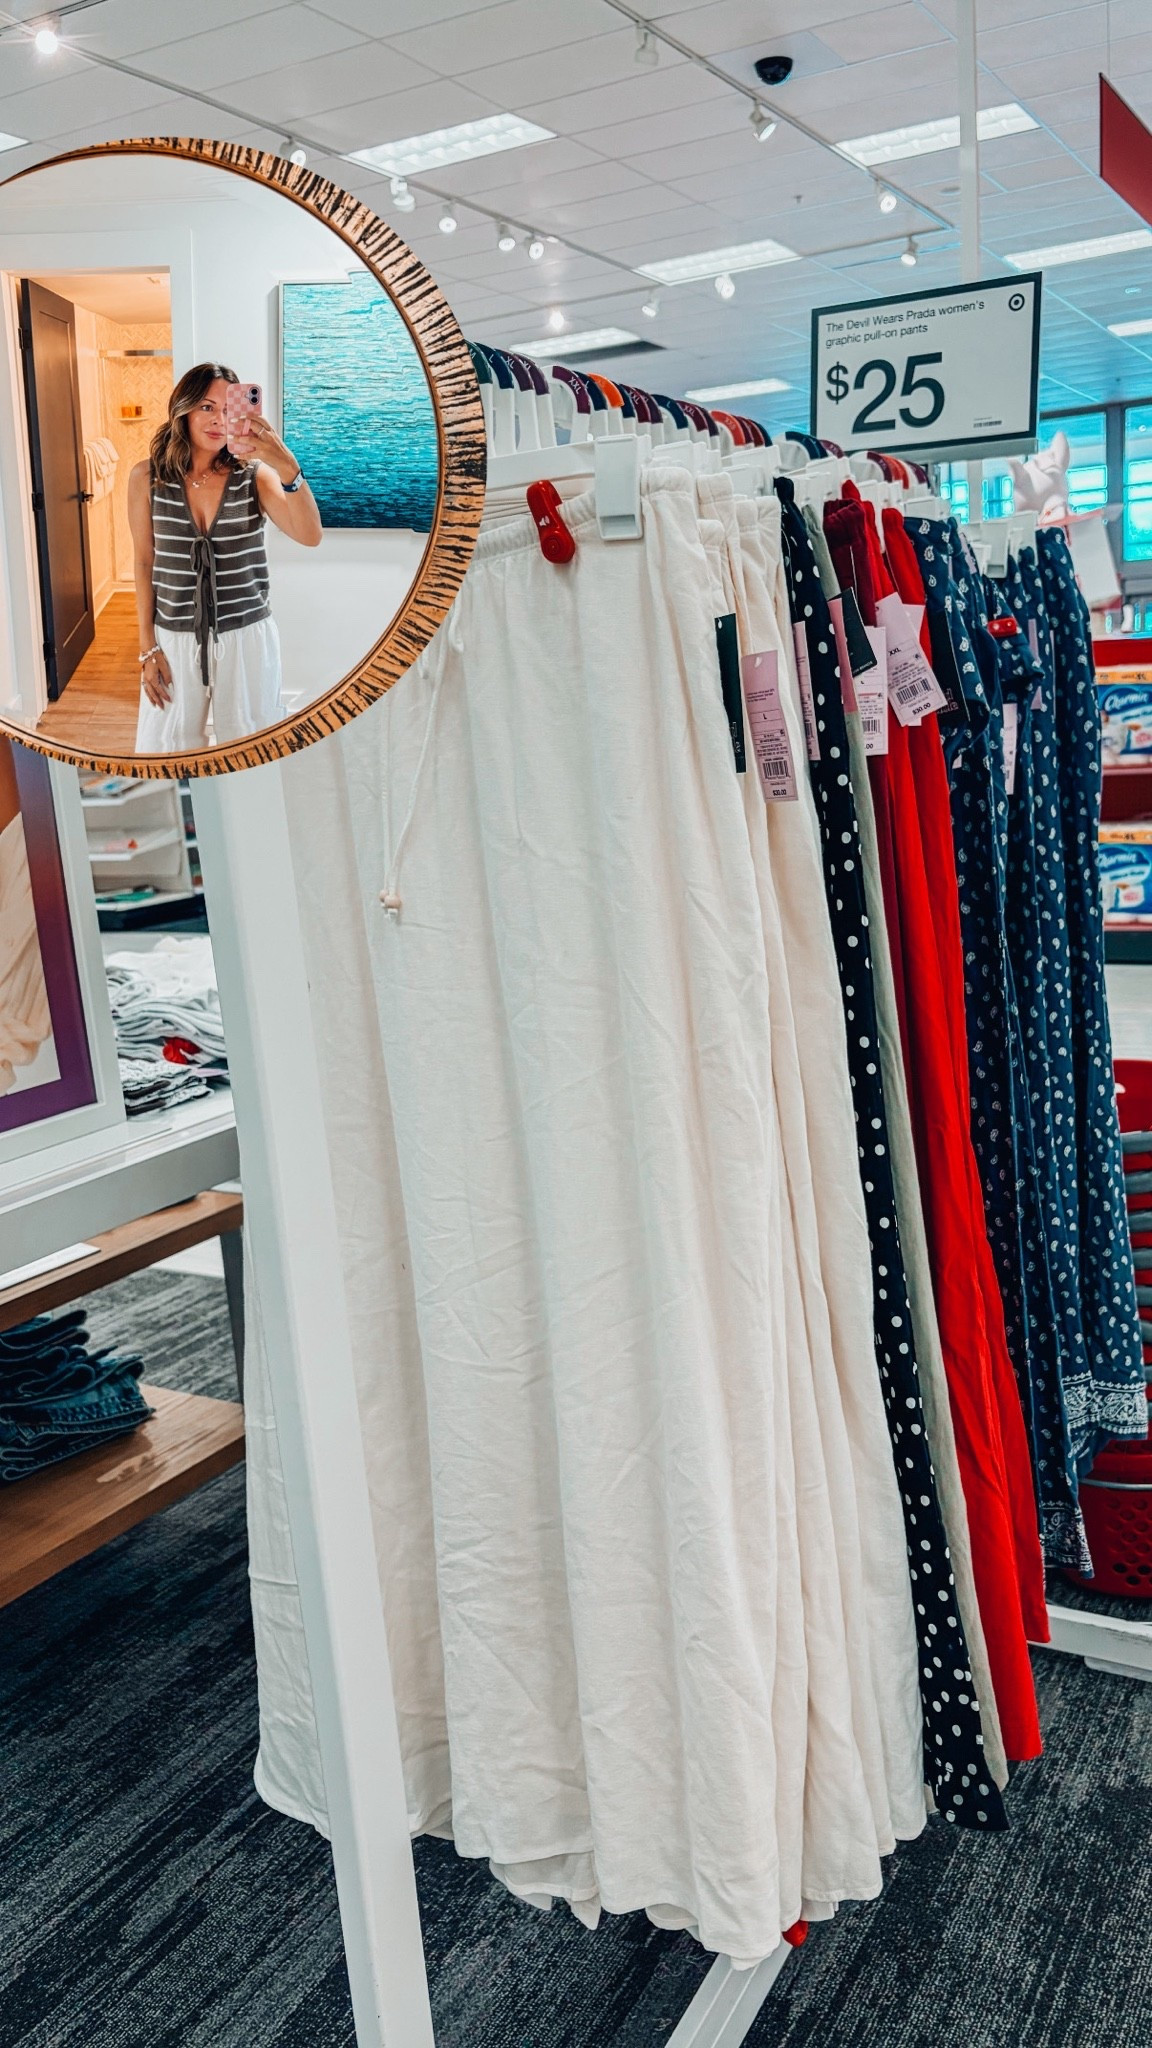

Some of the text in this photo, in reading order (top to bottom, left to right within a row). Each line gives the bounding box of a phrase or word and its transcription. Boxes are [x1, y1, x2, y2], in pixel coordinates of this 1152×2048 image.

[826, 300, 985, 333] The Devil Wears Prada women's
[825, 324, 928, 349] graphic pull-on pants
[488, 353, 495, 363] L
[505, 356, 515, 369] XL
[569, 376, 582, 395] XXL
[825, 351, 945, 434] $25
[629, 390, 641, 405] XXL
[684, 405, 696, 417] XXL
[888, 647, 902, 656] XXL
[912, 702, 931, 715] $30.00
[1104, 692, 1149, 711] Charmin
